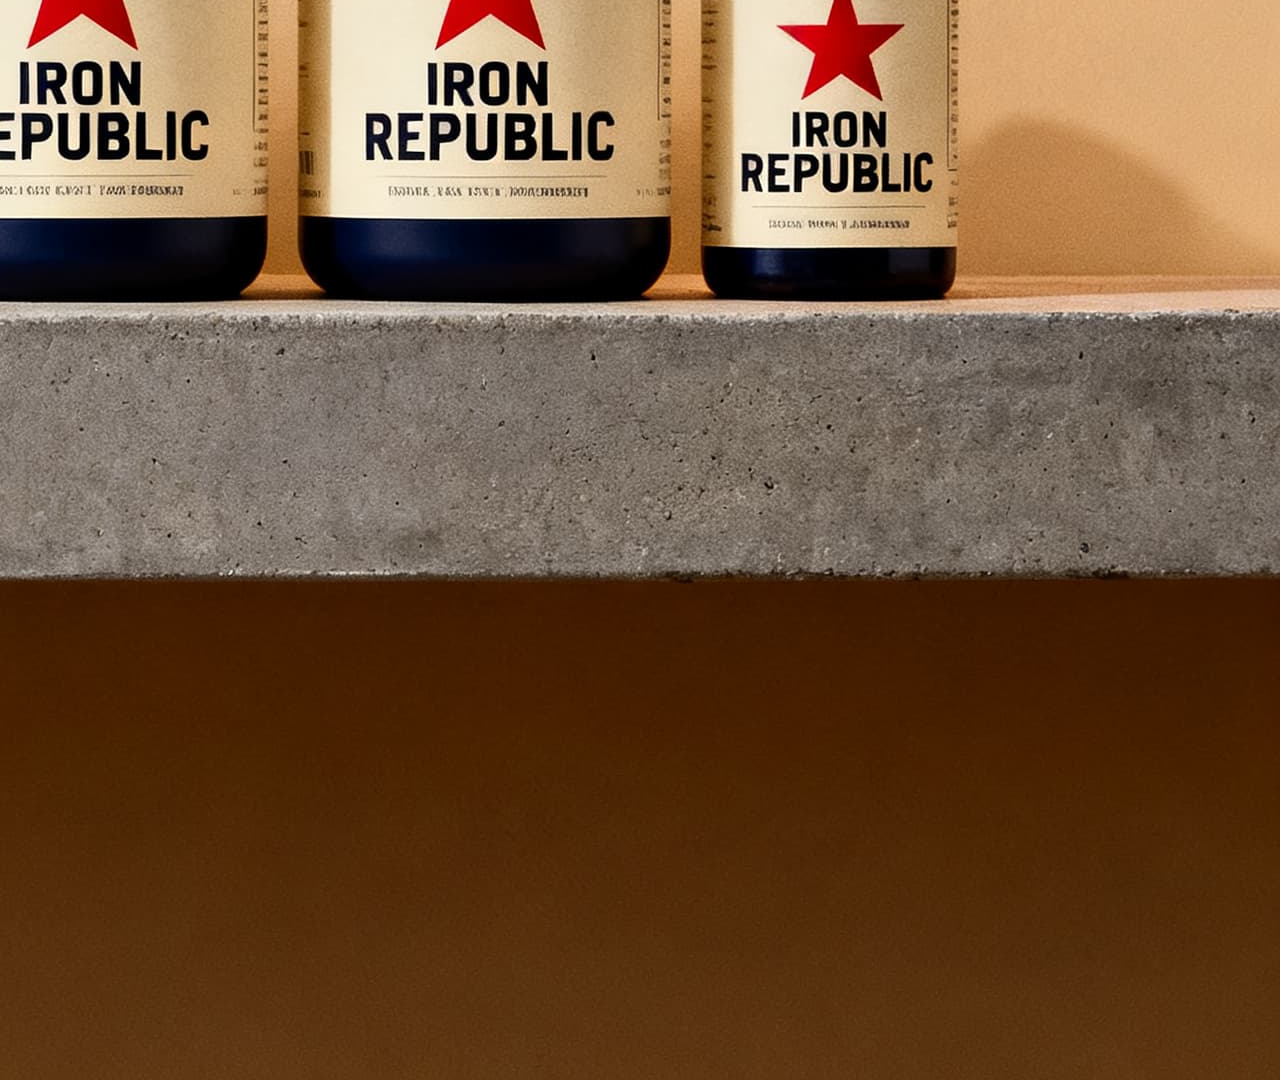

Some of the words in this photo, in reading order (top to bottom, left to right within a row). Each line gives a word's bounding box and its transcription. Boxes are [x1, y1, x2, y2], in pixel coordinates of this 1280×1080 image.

[18, 60, 142, 107] IRON
[427, 60, 549, 107] IRON
[365, 110, 616, 162] REPUBLIC
[791, 110, 887, 149] IRON
[740, 151, 934, 194] REPUBLIC
